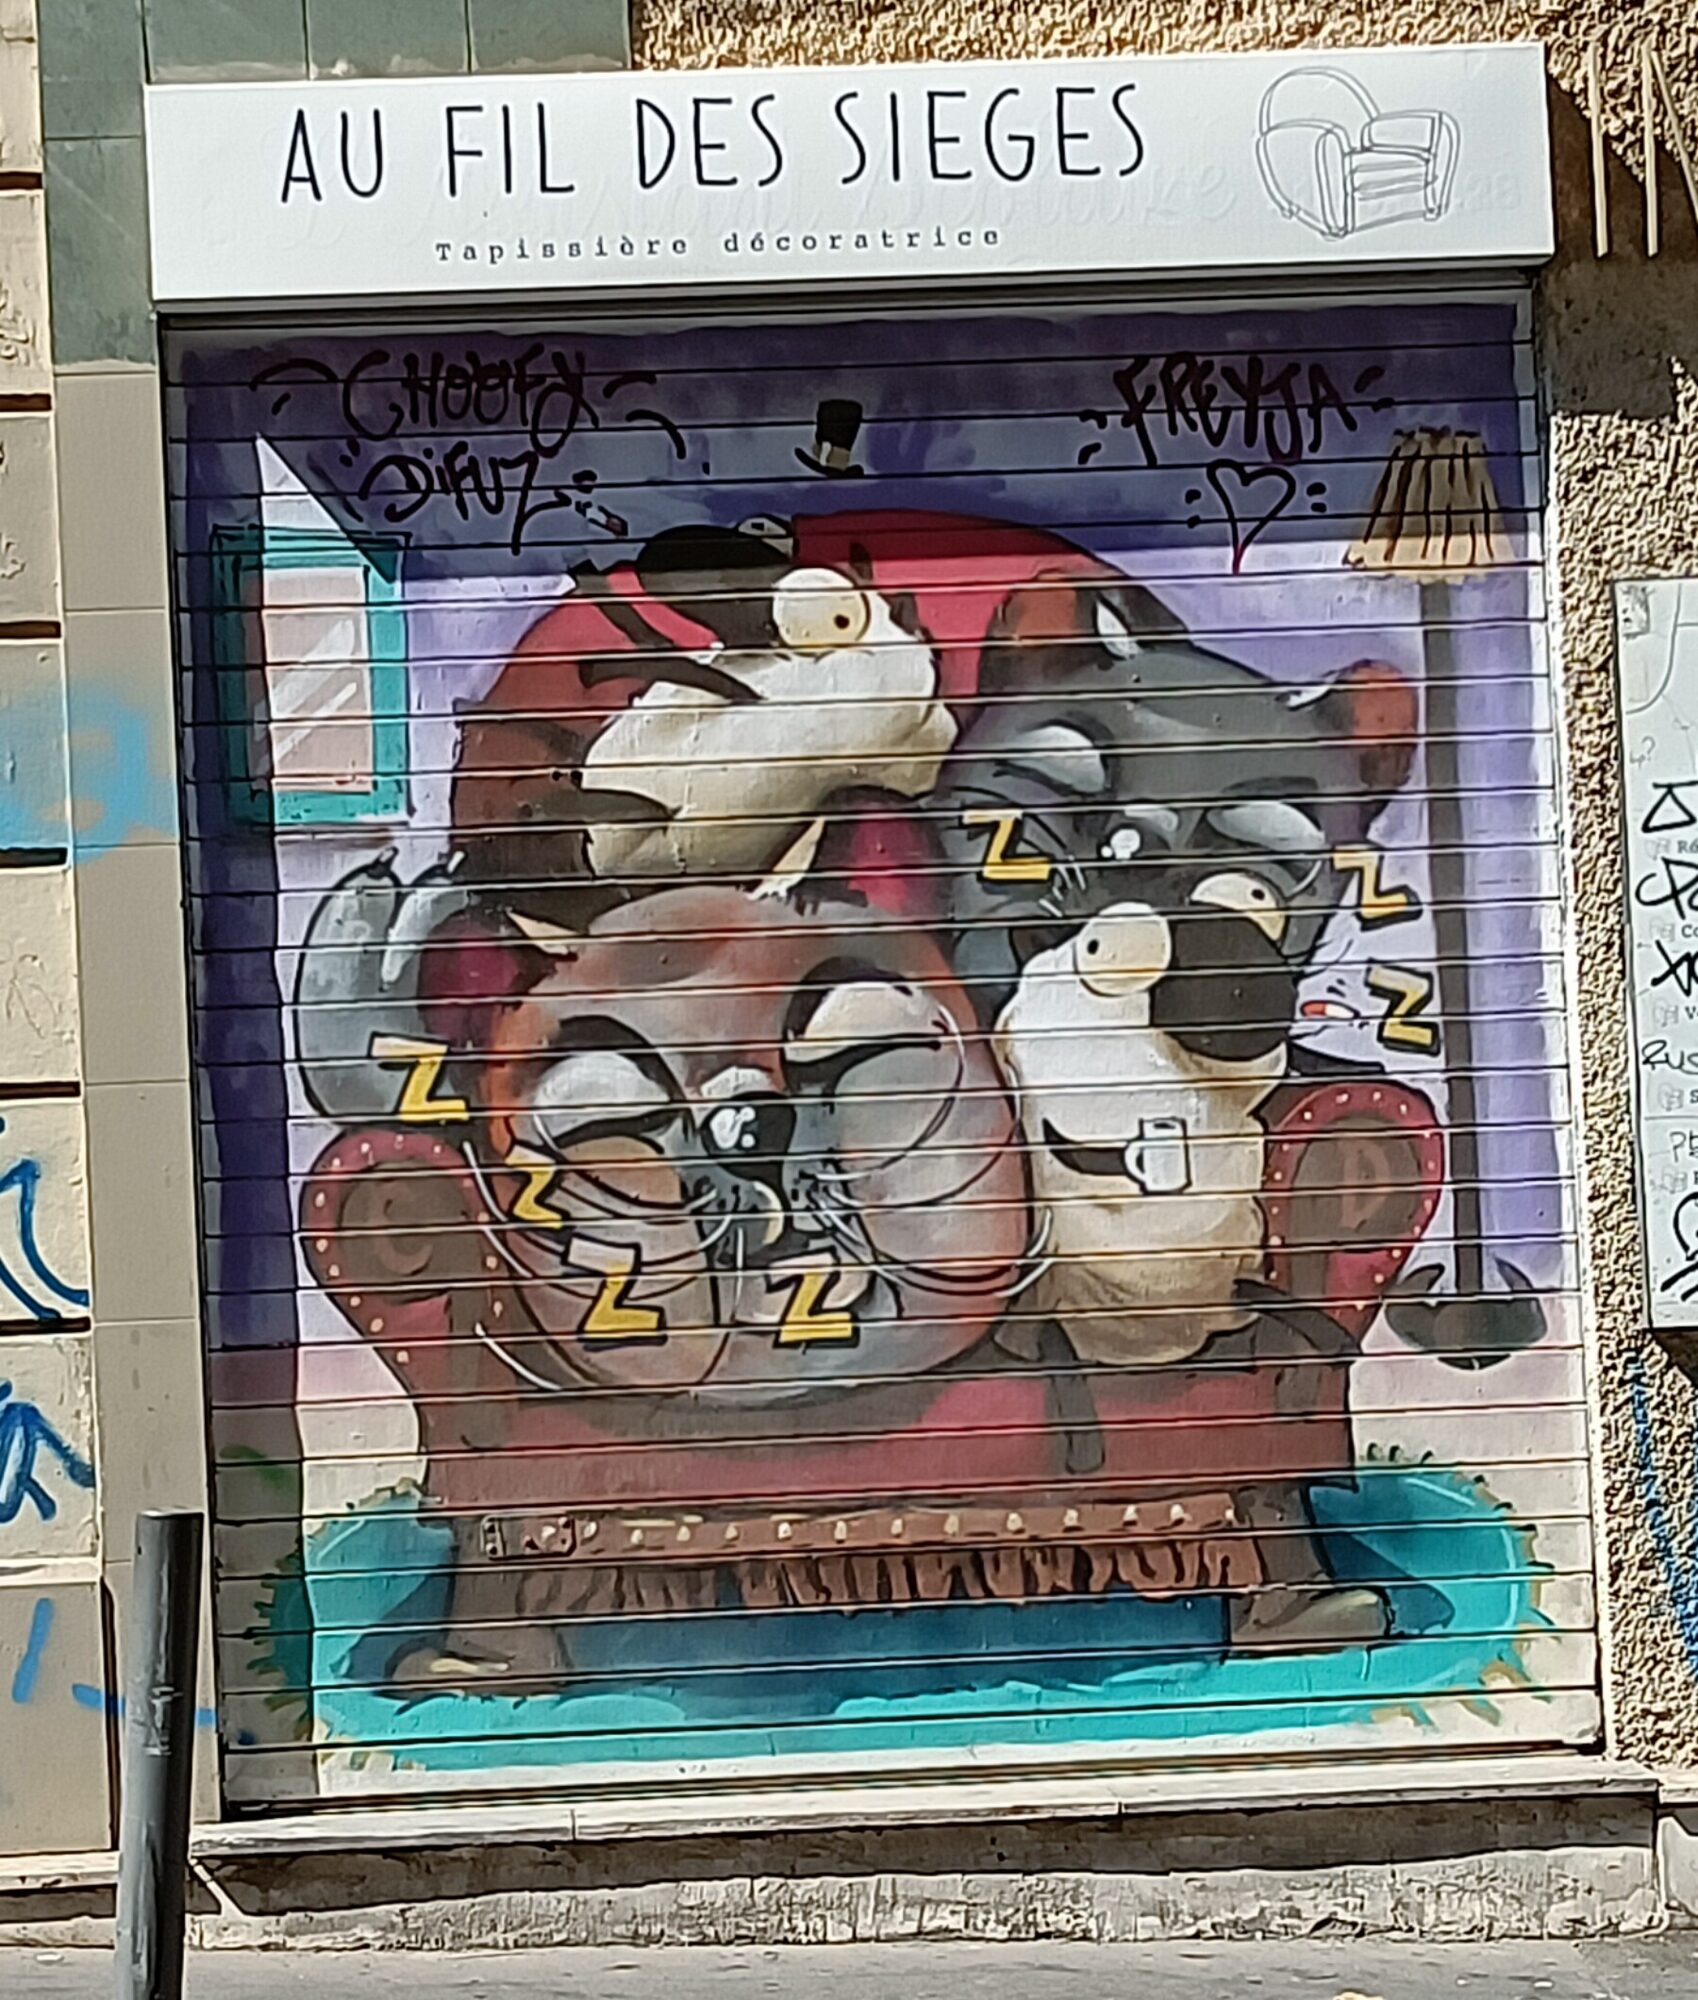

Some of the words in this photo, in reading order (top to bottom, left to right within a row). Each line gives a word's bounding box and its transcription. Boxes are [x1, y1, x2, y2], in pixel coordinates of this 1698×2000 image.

[281, 108, 385, 203] AU
[445, 101, 576, 197] FIL
[635, 94, 783, 189] DES
[833, 82, 1146, 185] SIEGES
[723, 225, 999, 253] décoratrice
